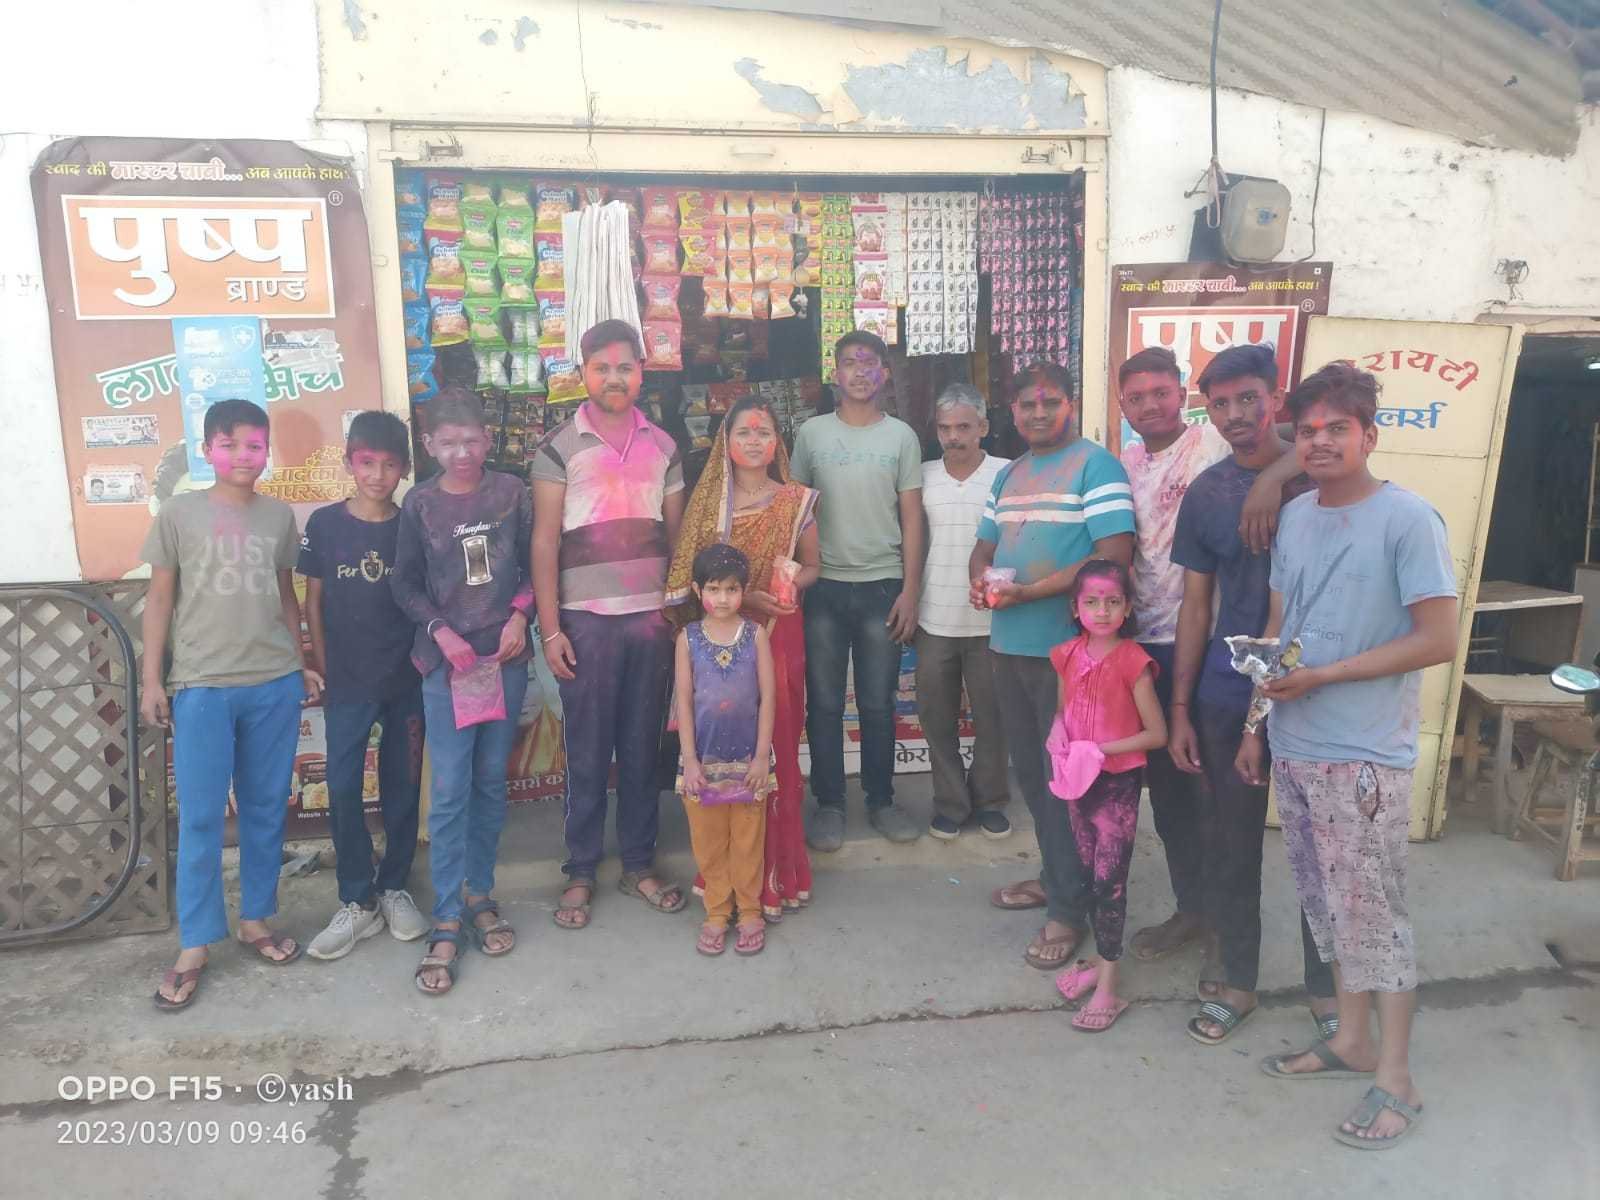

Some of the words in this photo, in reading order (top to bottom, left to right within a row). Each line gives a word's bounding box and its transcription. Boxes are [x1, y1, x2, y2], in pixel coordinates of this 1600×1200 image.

[87, 160, 107, 176] की
[109, 161, 178, 180] मास्टर
[245, 167, 270, 180] अब
[273, 163, 316, 180] आपके
[79, 206, 313, 307] पुष्प
[224, 276, 309, 302] ब्राण्ड
[1147, 279, 1160, 292] की
[1162, 279, 1205, 292] मास्टर
[1375, 401, 1448, 430] लर्स
